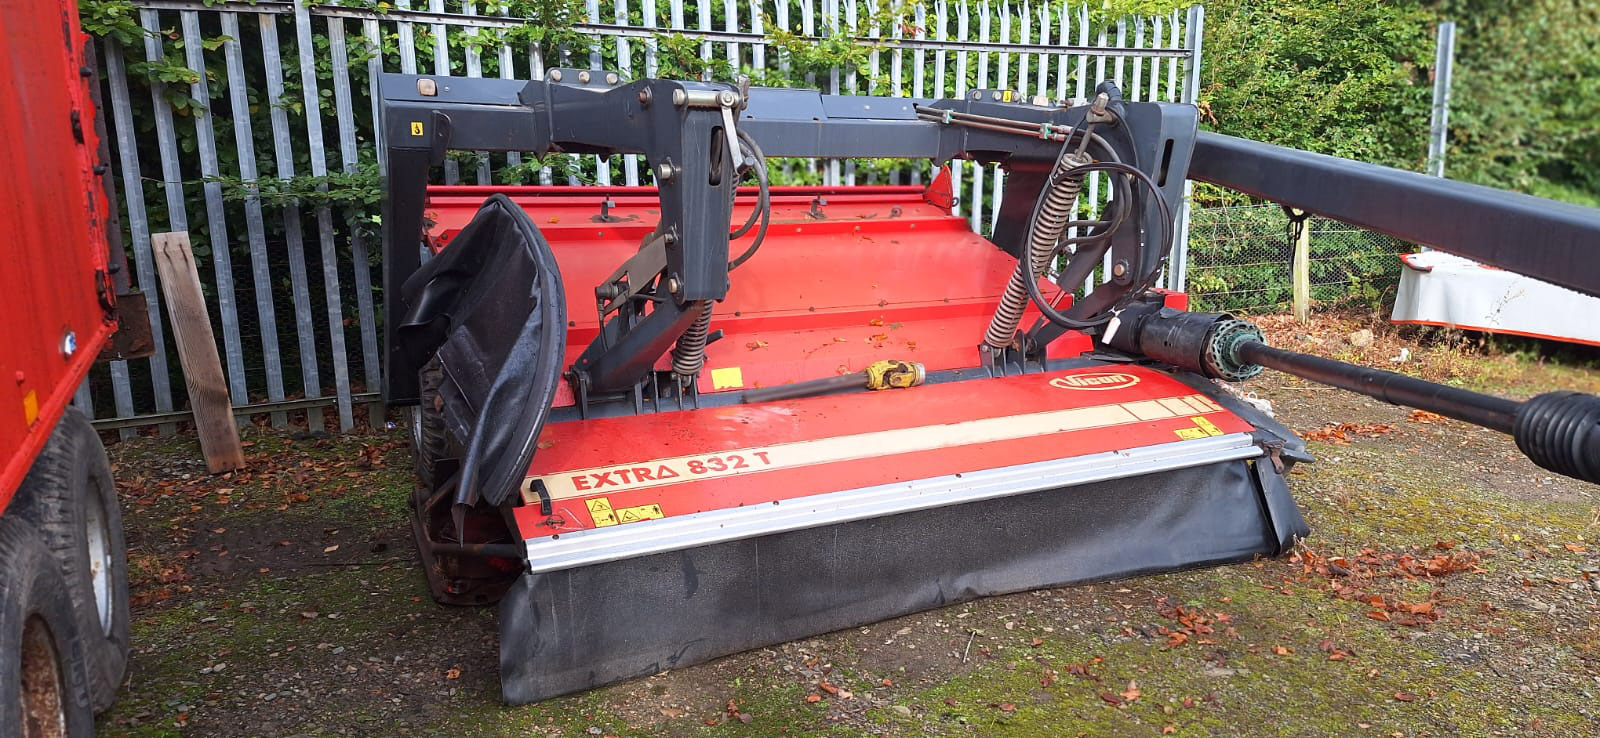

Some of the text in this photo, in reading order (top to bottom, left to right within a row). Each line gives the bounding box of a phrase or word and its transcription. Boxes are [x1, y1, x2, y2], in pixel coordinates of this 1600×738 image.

[1062, 374, 1128, 387] Vicon
[571, 452, 771, 491] EXTRA 832 T
